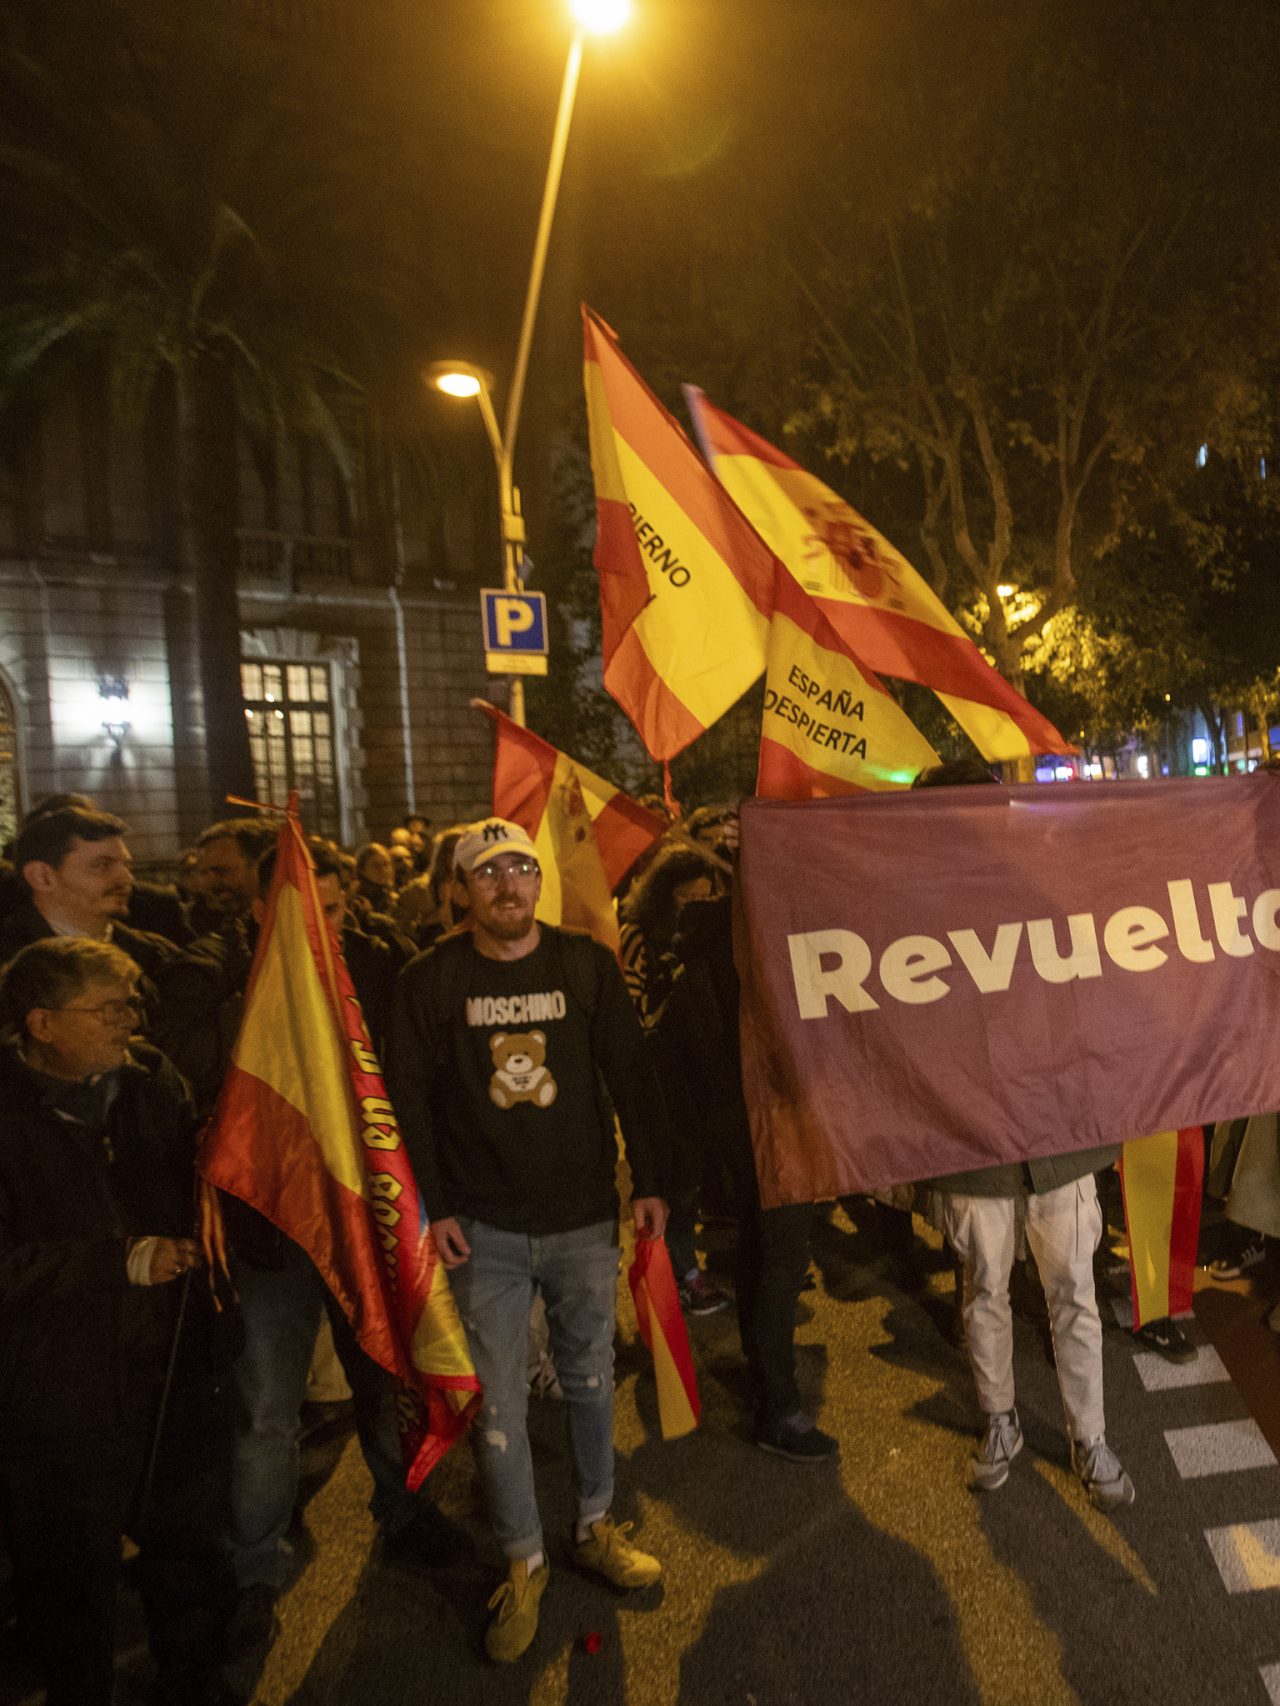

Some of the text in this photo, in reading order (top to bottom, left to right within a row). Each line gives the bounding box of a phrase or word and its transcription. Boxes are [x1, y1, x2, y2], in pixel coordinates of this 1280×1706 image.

[494, 597, 534, 646] P
[787, 664, 864, 722] ESPAÑA
[764, 688, 867, 760] DESPIERTA
[466, 990, 566, 1027] MOSCHINO
